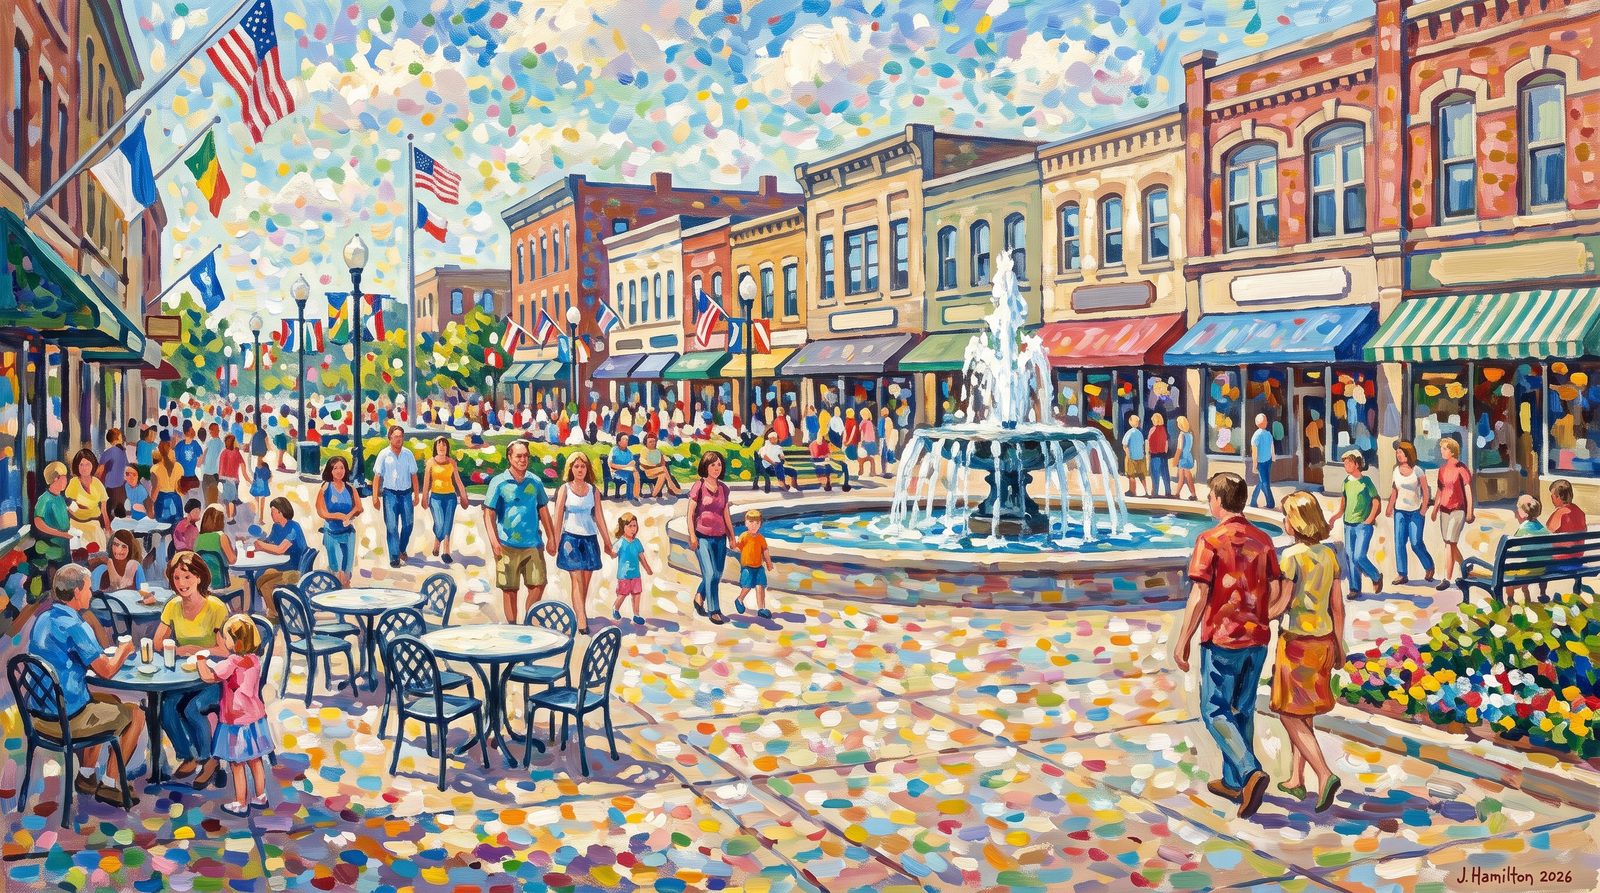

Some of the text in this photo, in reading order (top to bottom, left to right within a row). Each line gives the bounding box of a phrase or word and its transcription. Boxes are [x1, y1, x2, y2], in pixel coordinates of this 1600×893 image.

[1456, 866, 1573, 886] J. Hamilton 2026
